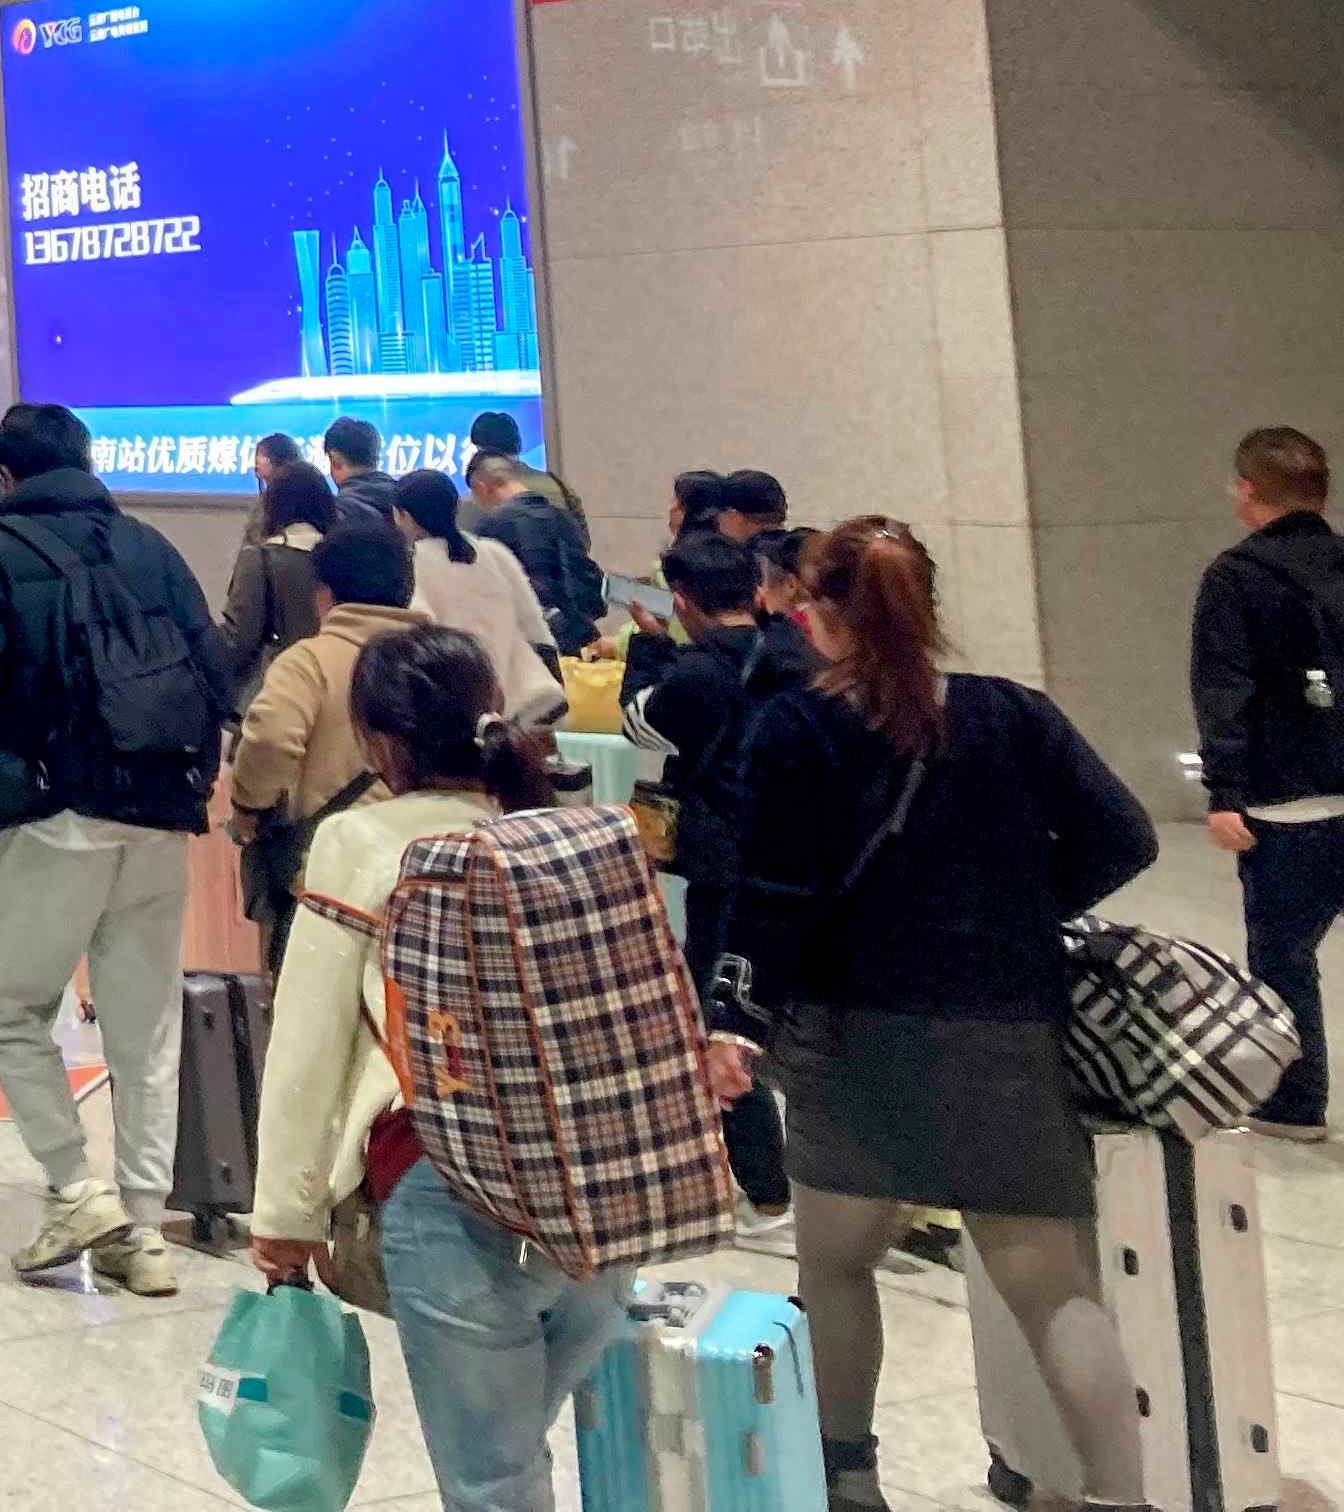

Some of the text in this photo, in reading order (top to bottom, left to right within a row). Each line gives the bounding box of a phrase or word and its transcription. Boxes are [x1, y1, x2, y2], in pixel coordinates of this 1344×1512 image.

[22, 161, 142, 221] 招商电话
[25, 215, 201, 264] 13678728722
